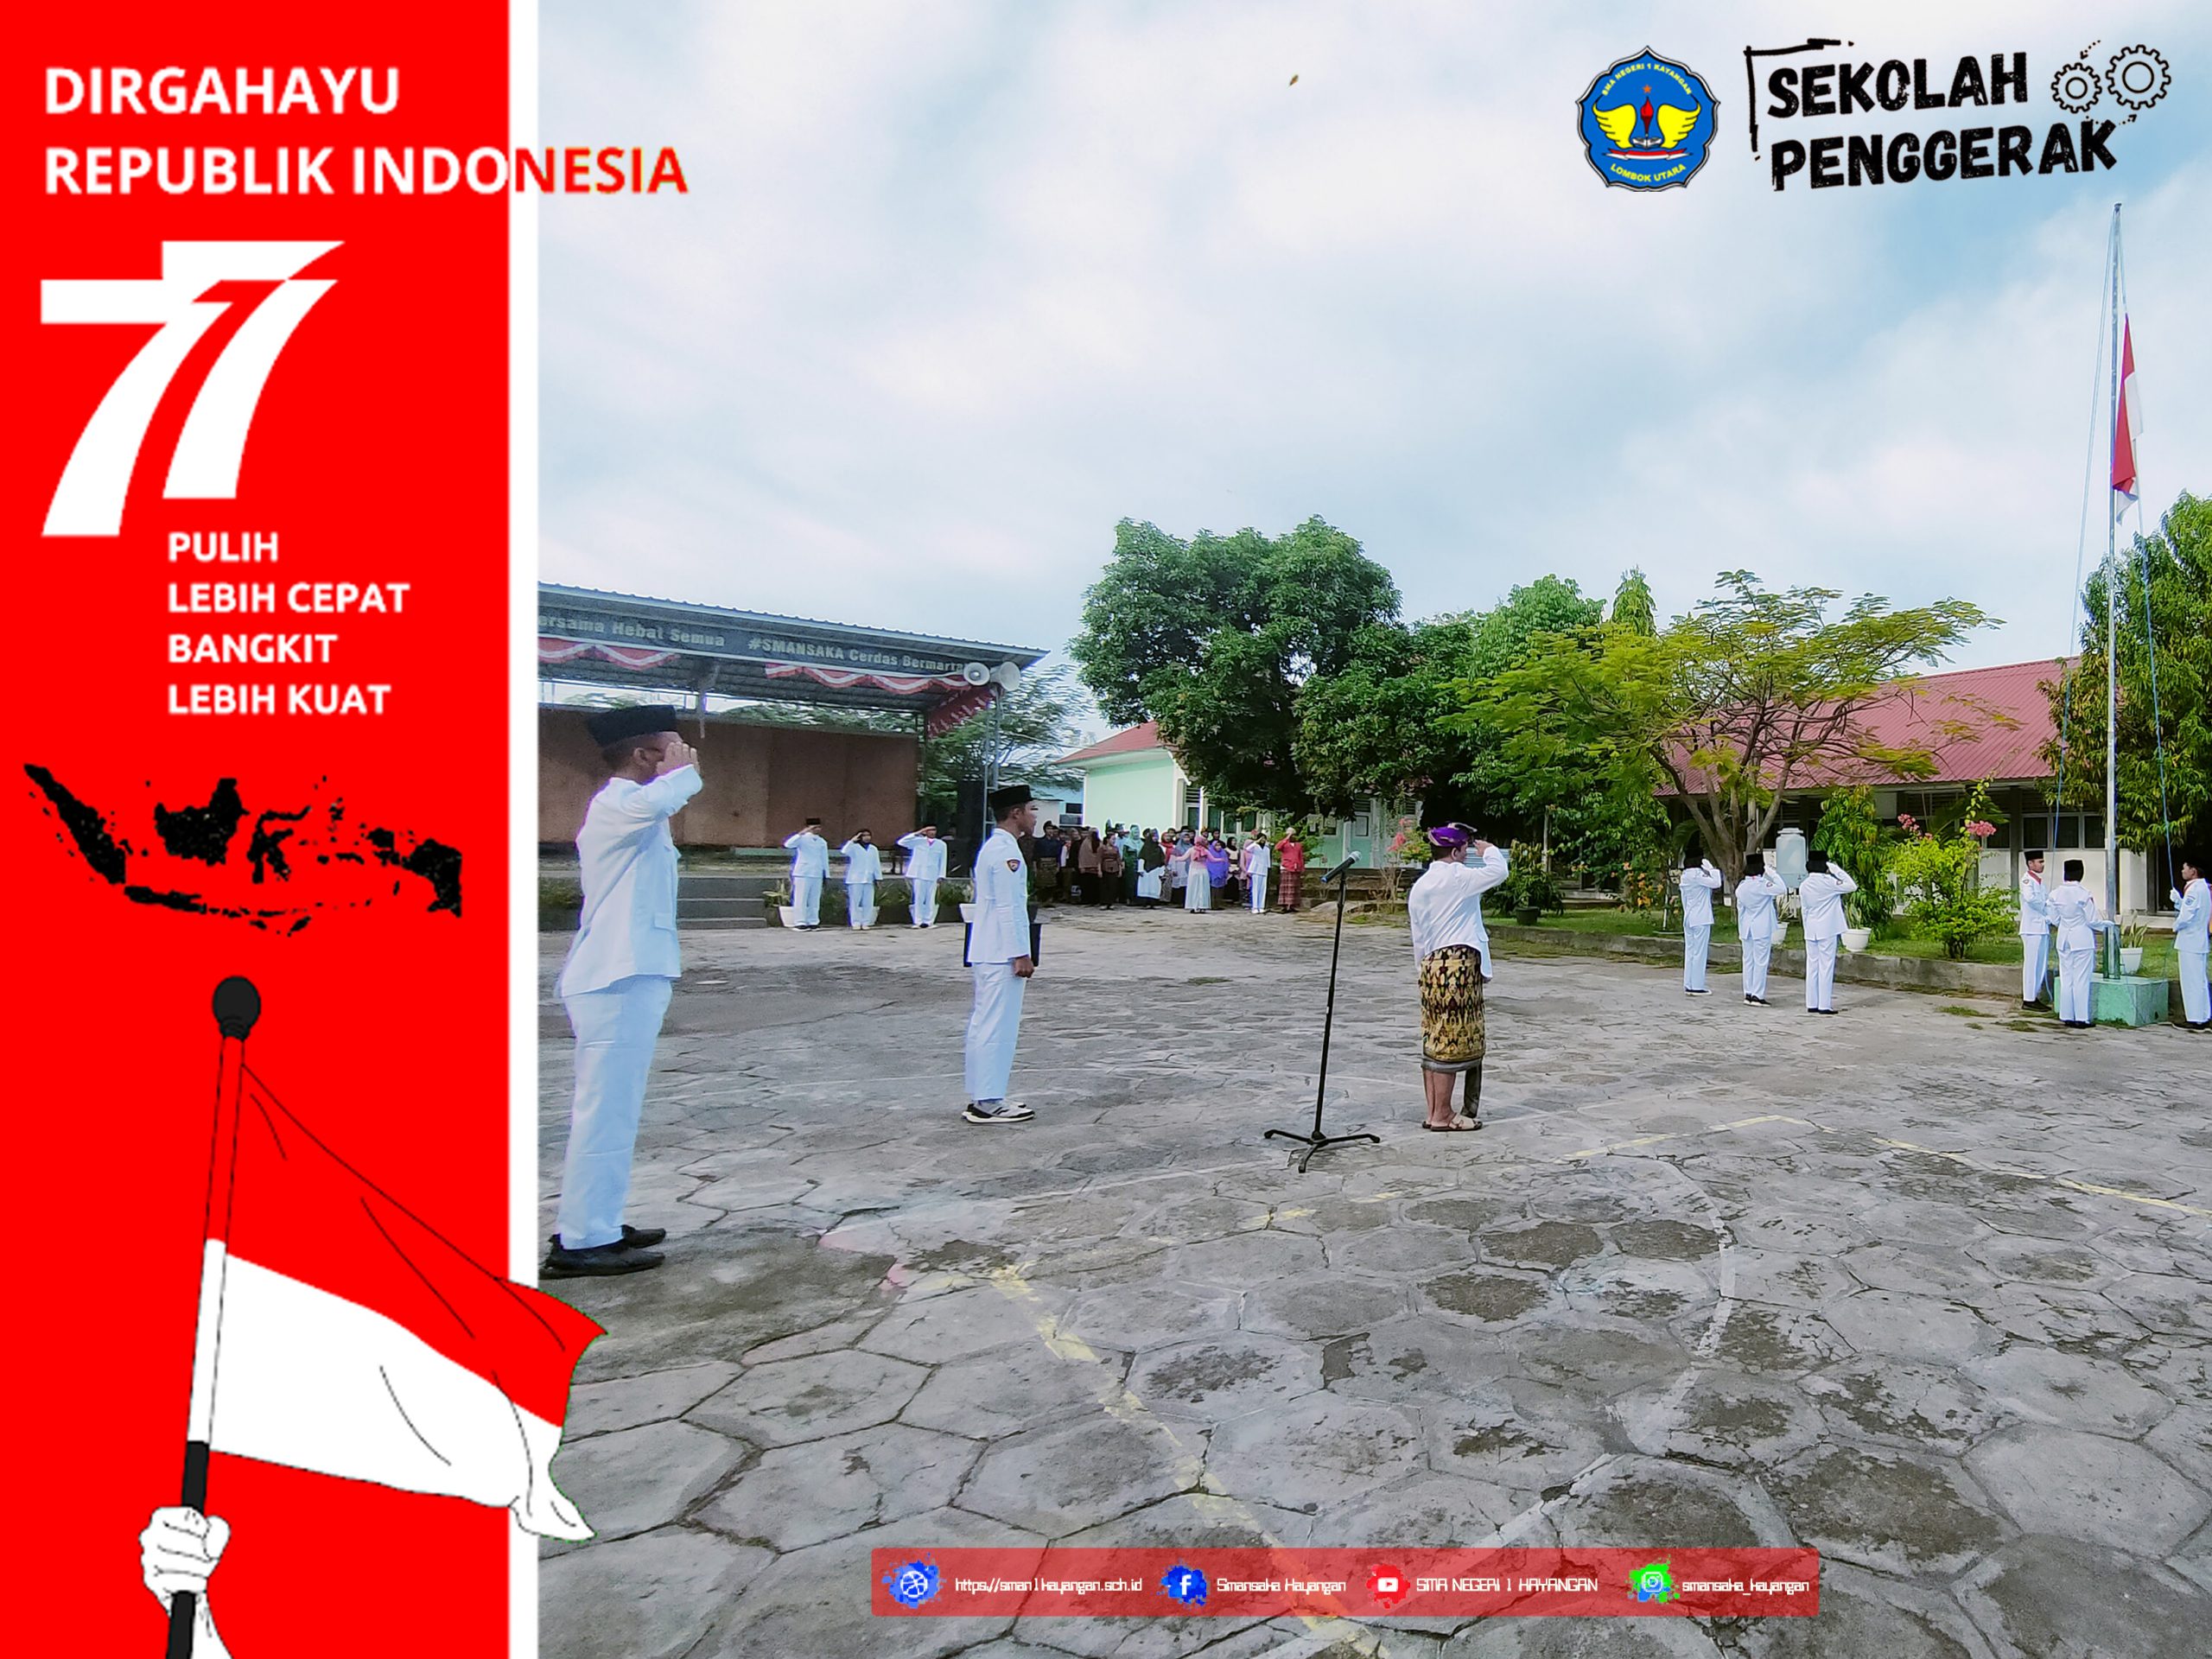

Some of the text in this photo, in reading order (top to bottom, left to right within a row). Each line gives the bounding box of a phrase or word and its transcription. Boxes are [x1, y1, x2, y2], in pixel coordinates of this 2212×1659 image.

[537, 614, 725, 646] ersama Hebat Semua
[748, 638, 965, 673] #SMANSAKA Cerdas Bermarta
